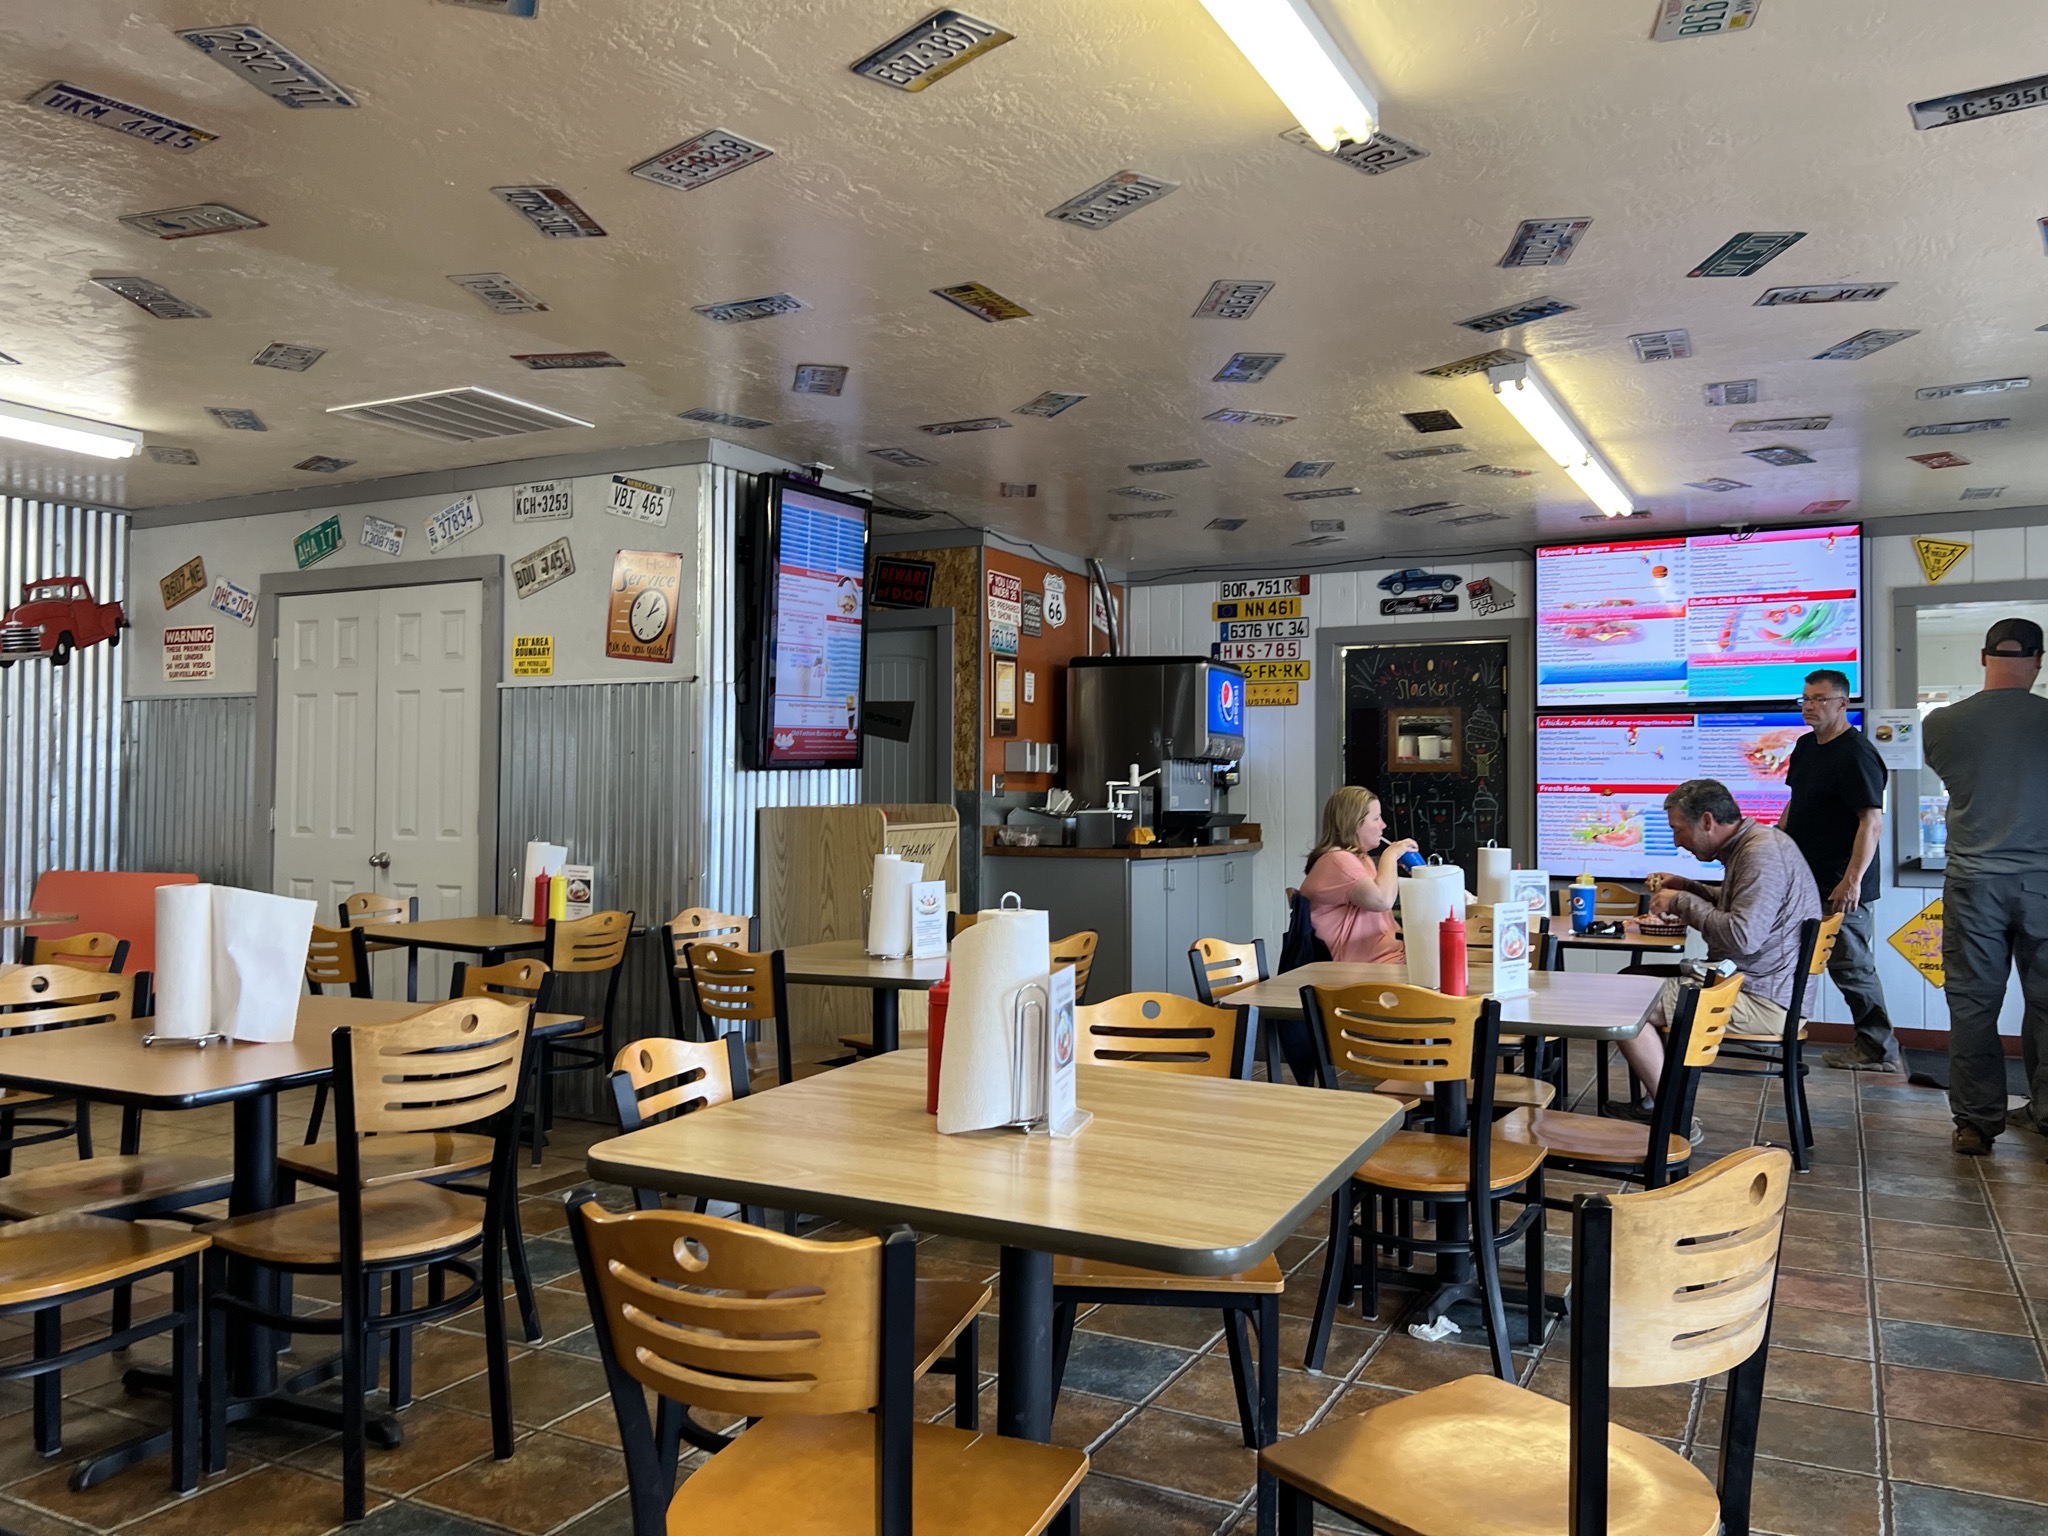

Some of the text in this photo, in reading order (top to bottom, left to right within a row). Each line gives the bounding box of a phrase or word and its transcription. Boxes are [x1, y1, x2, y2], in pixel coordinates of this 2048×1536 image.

[112, 114, 206, 150] 4415
[659, 143, 701, 165] MAINE
[531, 484, 554, 493] TEXAS
[626, 480, 657, 492] NEBRASKA
[614, 485, 664, 516] VBI 465
[433, 501, 466, 522] KANSAS
[438, 505, 474, 540] 37834
[321, 525, 339, 549] 177
[1578, 546, 1610, 555] Burgers
[515, 564, 537, 589] BDU
[616, 569, 675, 592] Service
[881, 567, 927, 586] BEWARE
[995, 575, 1005, 587] YOU
[1006, 579, 1020, 590] LOOK
[878, 587, 924, 602] of DOG
[992, 585, 1017, 601] UNDER 25
[1223, 583, 1247, 598] BOR
[1257, 580, 1280, 595] 751
[236, 595, 254, 616] 709
[989, 599, 1019, 614] BE PREPARED
[1049, 602, 1062, 621] 66
[1245, 600, 1293, 617] NN 461
[990, 608, 996, 618] TO
[998, 610, 1011, 621] SHOW
[166, 629, 213, 643] WARNING
[1230, 621, 1304, 638] 6376 YC 34
[517, 636, 549, 647] SKI AREA
[515, 648, 550, 657] BOUNDARY
[1224, 642, 1296, 659] HWS-785
[1241, 664, 1303, 679] 6-FR-RK
[1570, 718, 1614, 726] Sandwiches
[900, 843, 936, 857] THANK
[1919, 963, 1944, 971] CROSS
